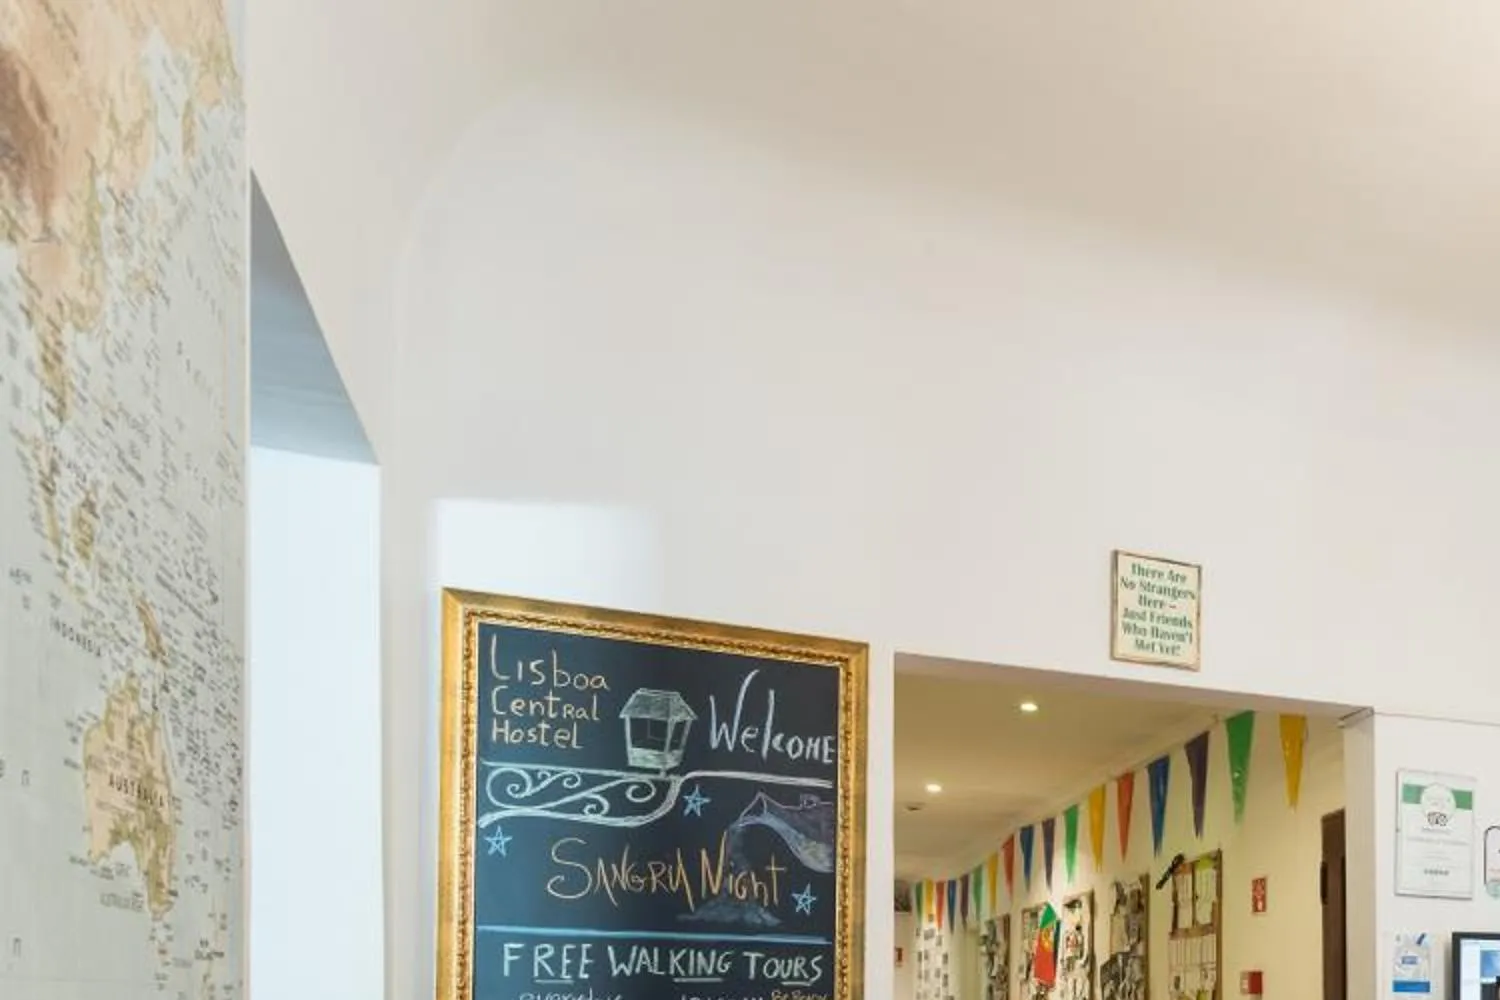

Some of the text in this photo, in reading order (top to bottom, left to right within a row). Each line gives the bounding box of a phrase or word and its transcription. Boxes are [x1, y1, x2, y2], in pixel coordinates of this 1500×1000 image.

[491, 717, 584, 749] Hostel
[503, 943, 823, 983] FREE WALKING TOURS
